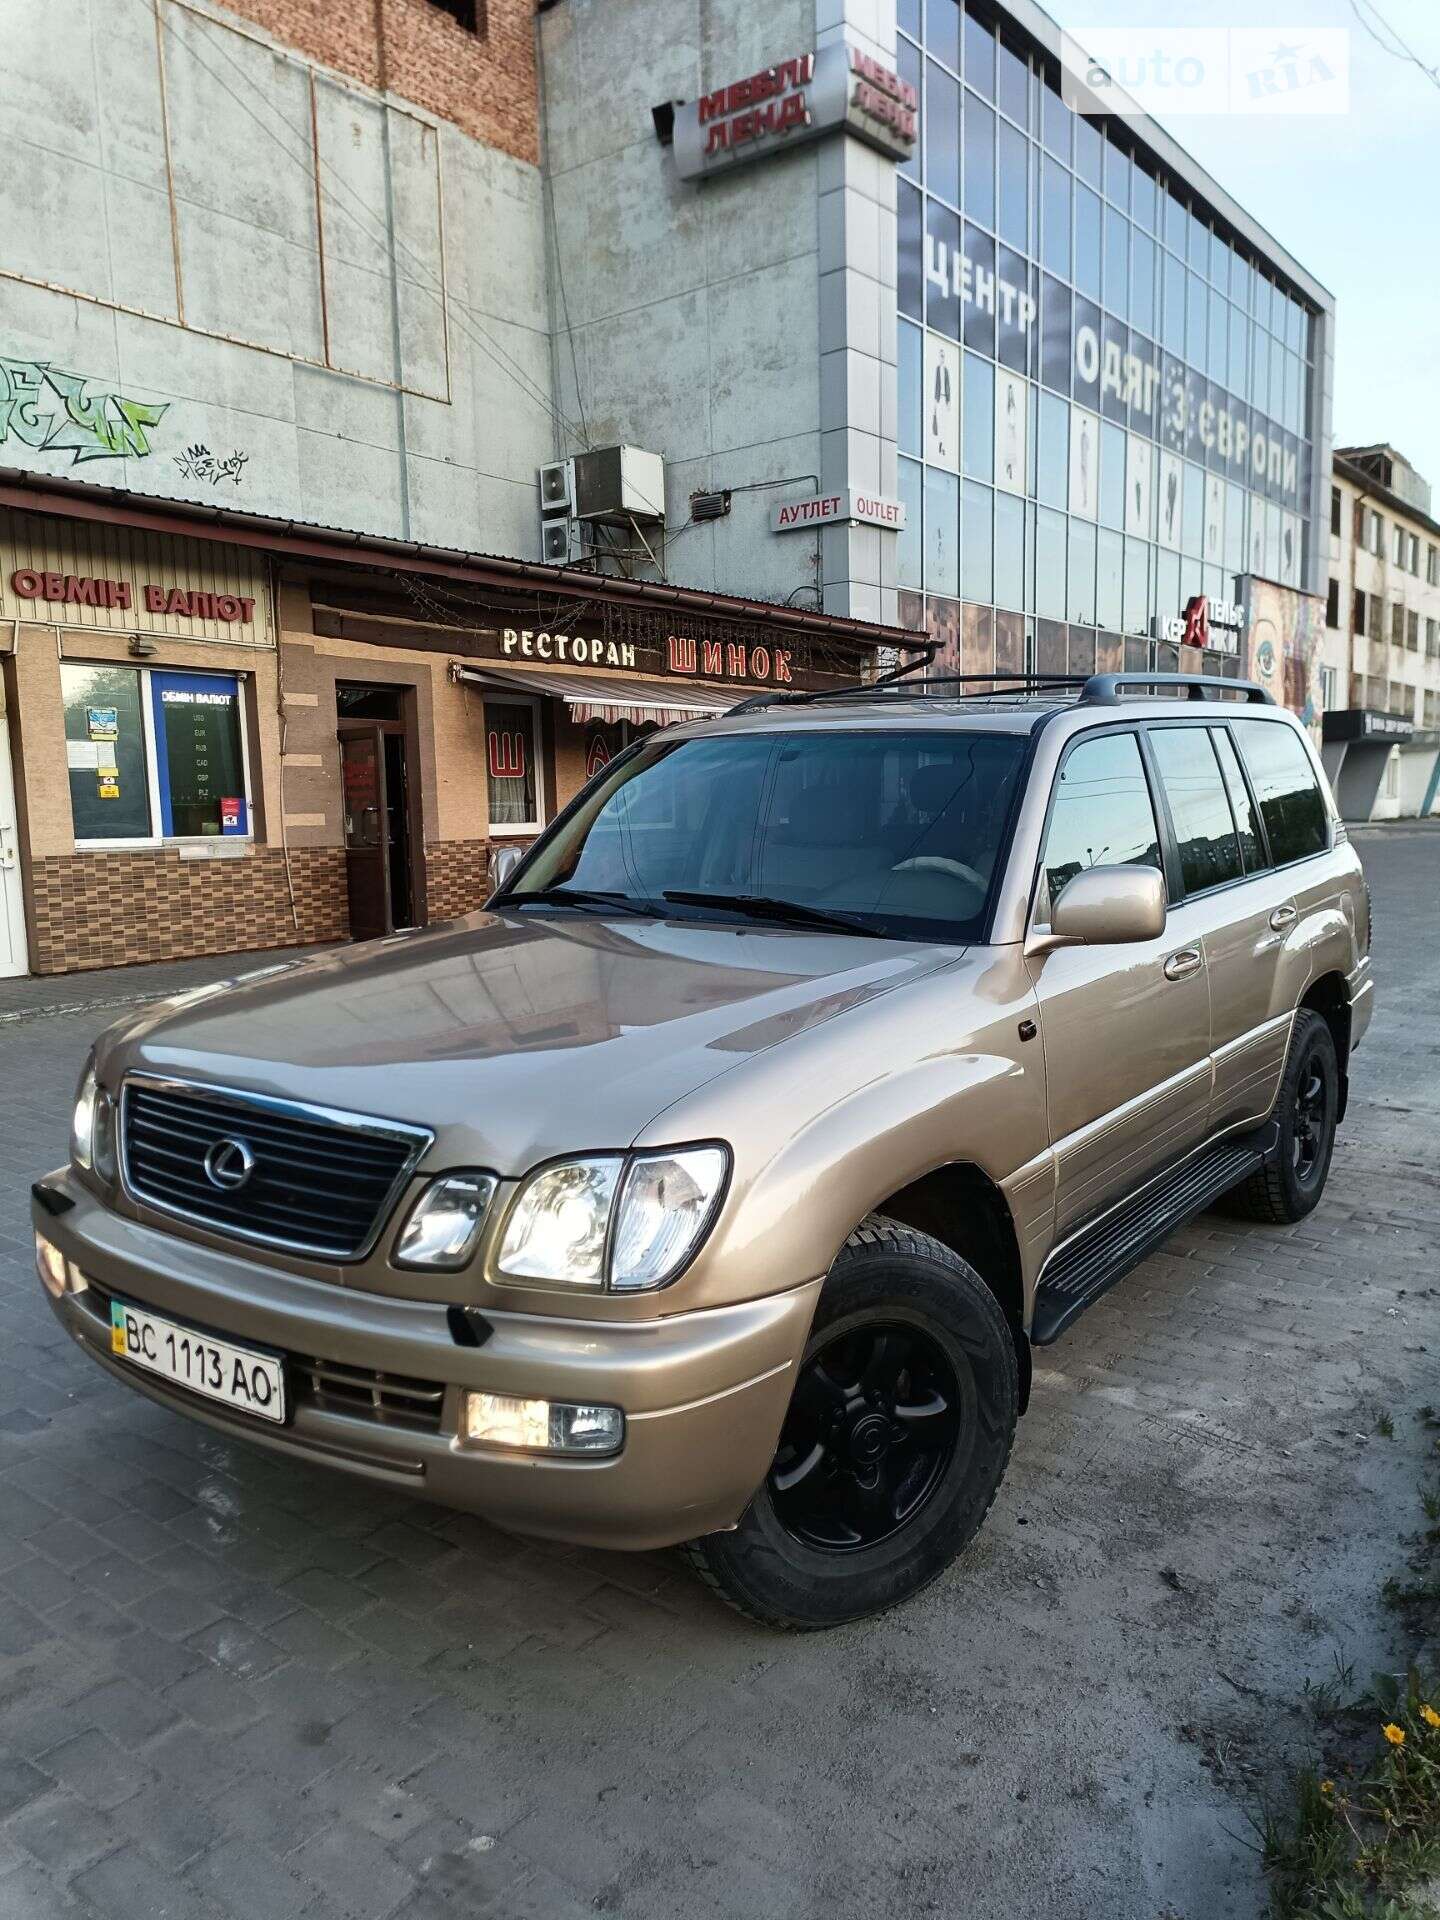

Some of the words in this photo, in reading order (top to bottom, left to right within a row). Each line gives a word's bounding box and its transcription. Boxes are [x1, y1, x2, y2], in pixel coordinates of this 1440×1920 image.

[698, 52, 815, 125] МЕБЛІ
[704, 92, 812, 154] ЛЕНД
[925, 232, 1037, 334] ЦЕНТР
[1076, 325, 1161, 416] ОДЯГ
[1199, 400, 1298, 494] ЄВРОПИ
[779, 497, 840, 524] АУТЛЕТ
[857, 497, 899, 523] OUTLET
[11, 568, 132, 609] ОБМІН
[143, 584, 256, 624] ВАЛЮТ
[502, 628, 636, 667] РЕСТОРАН
[668, 635, 793, 682] ШИНОК
[196, 694, 231, 705] ВАЛЮТ
[194, 729, 206, 737] EUR
[488, 731, 525, 778] Ш
[125, 1313, 157, 1361] BC
[165, 1332, 223, 1390] 1113
[231, 1357, 273, 1407] AO
